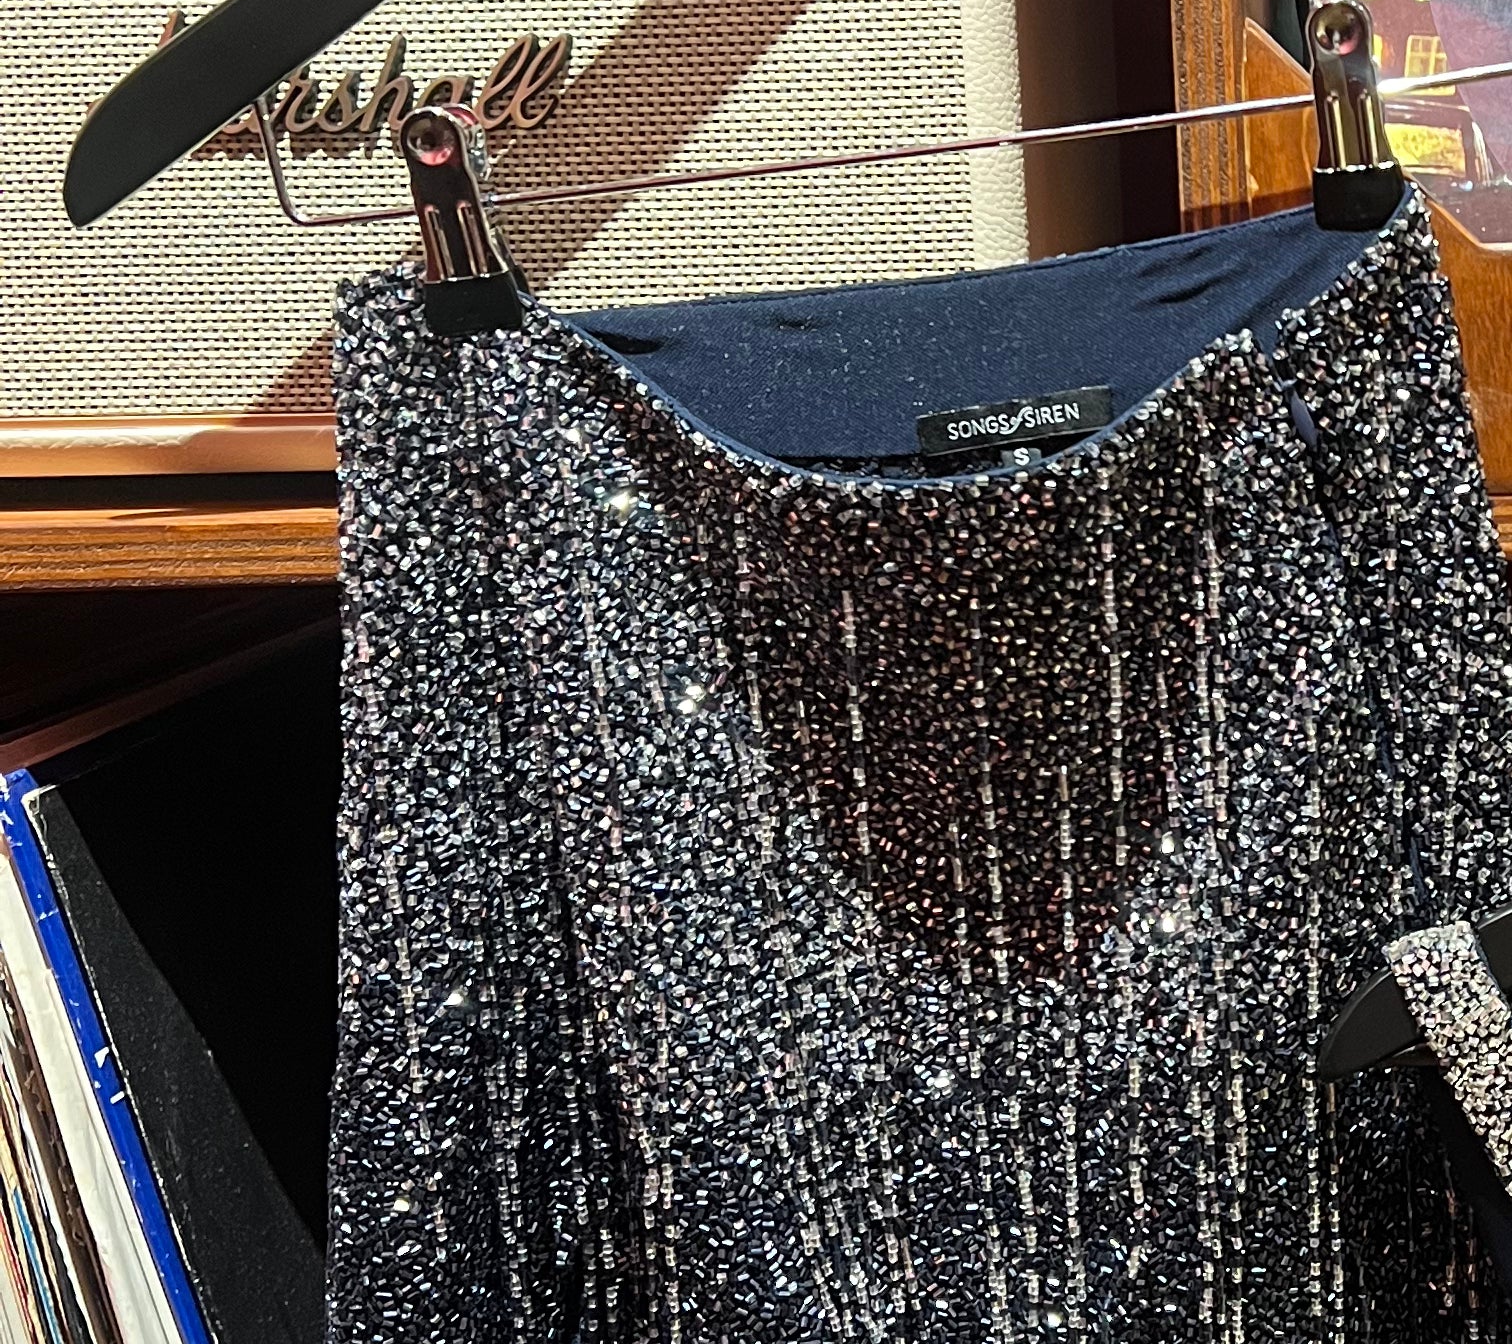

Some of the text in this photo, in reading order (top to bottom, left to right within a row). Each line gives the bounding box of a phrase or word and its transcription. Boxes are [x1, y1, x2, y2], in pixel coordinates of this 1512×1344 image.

[947, 413, 1009, 441] SONGS
[1024, 402, 1081, 429] SIREN
[1013, 447, 1031, 466] S
